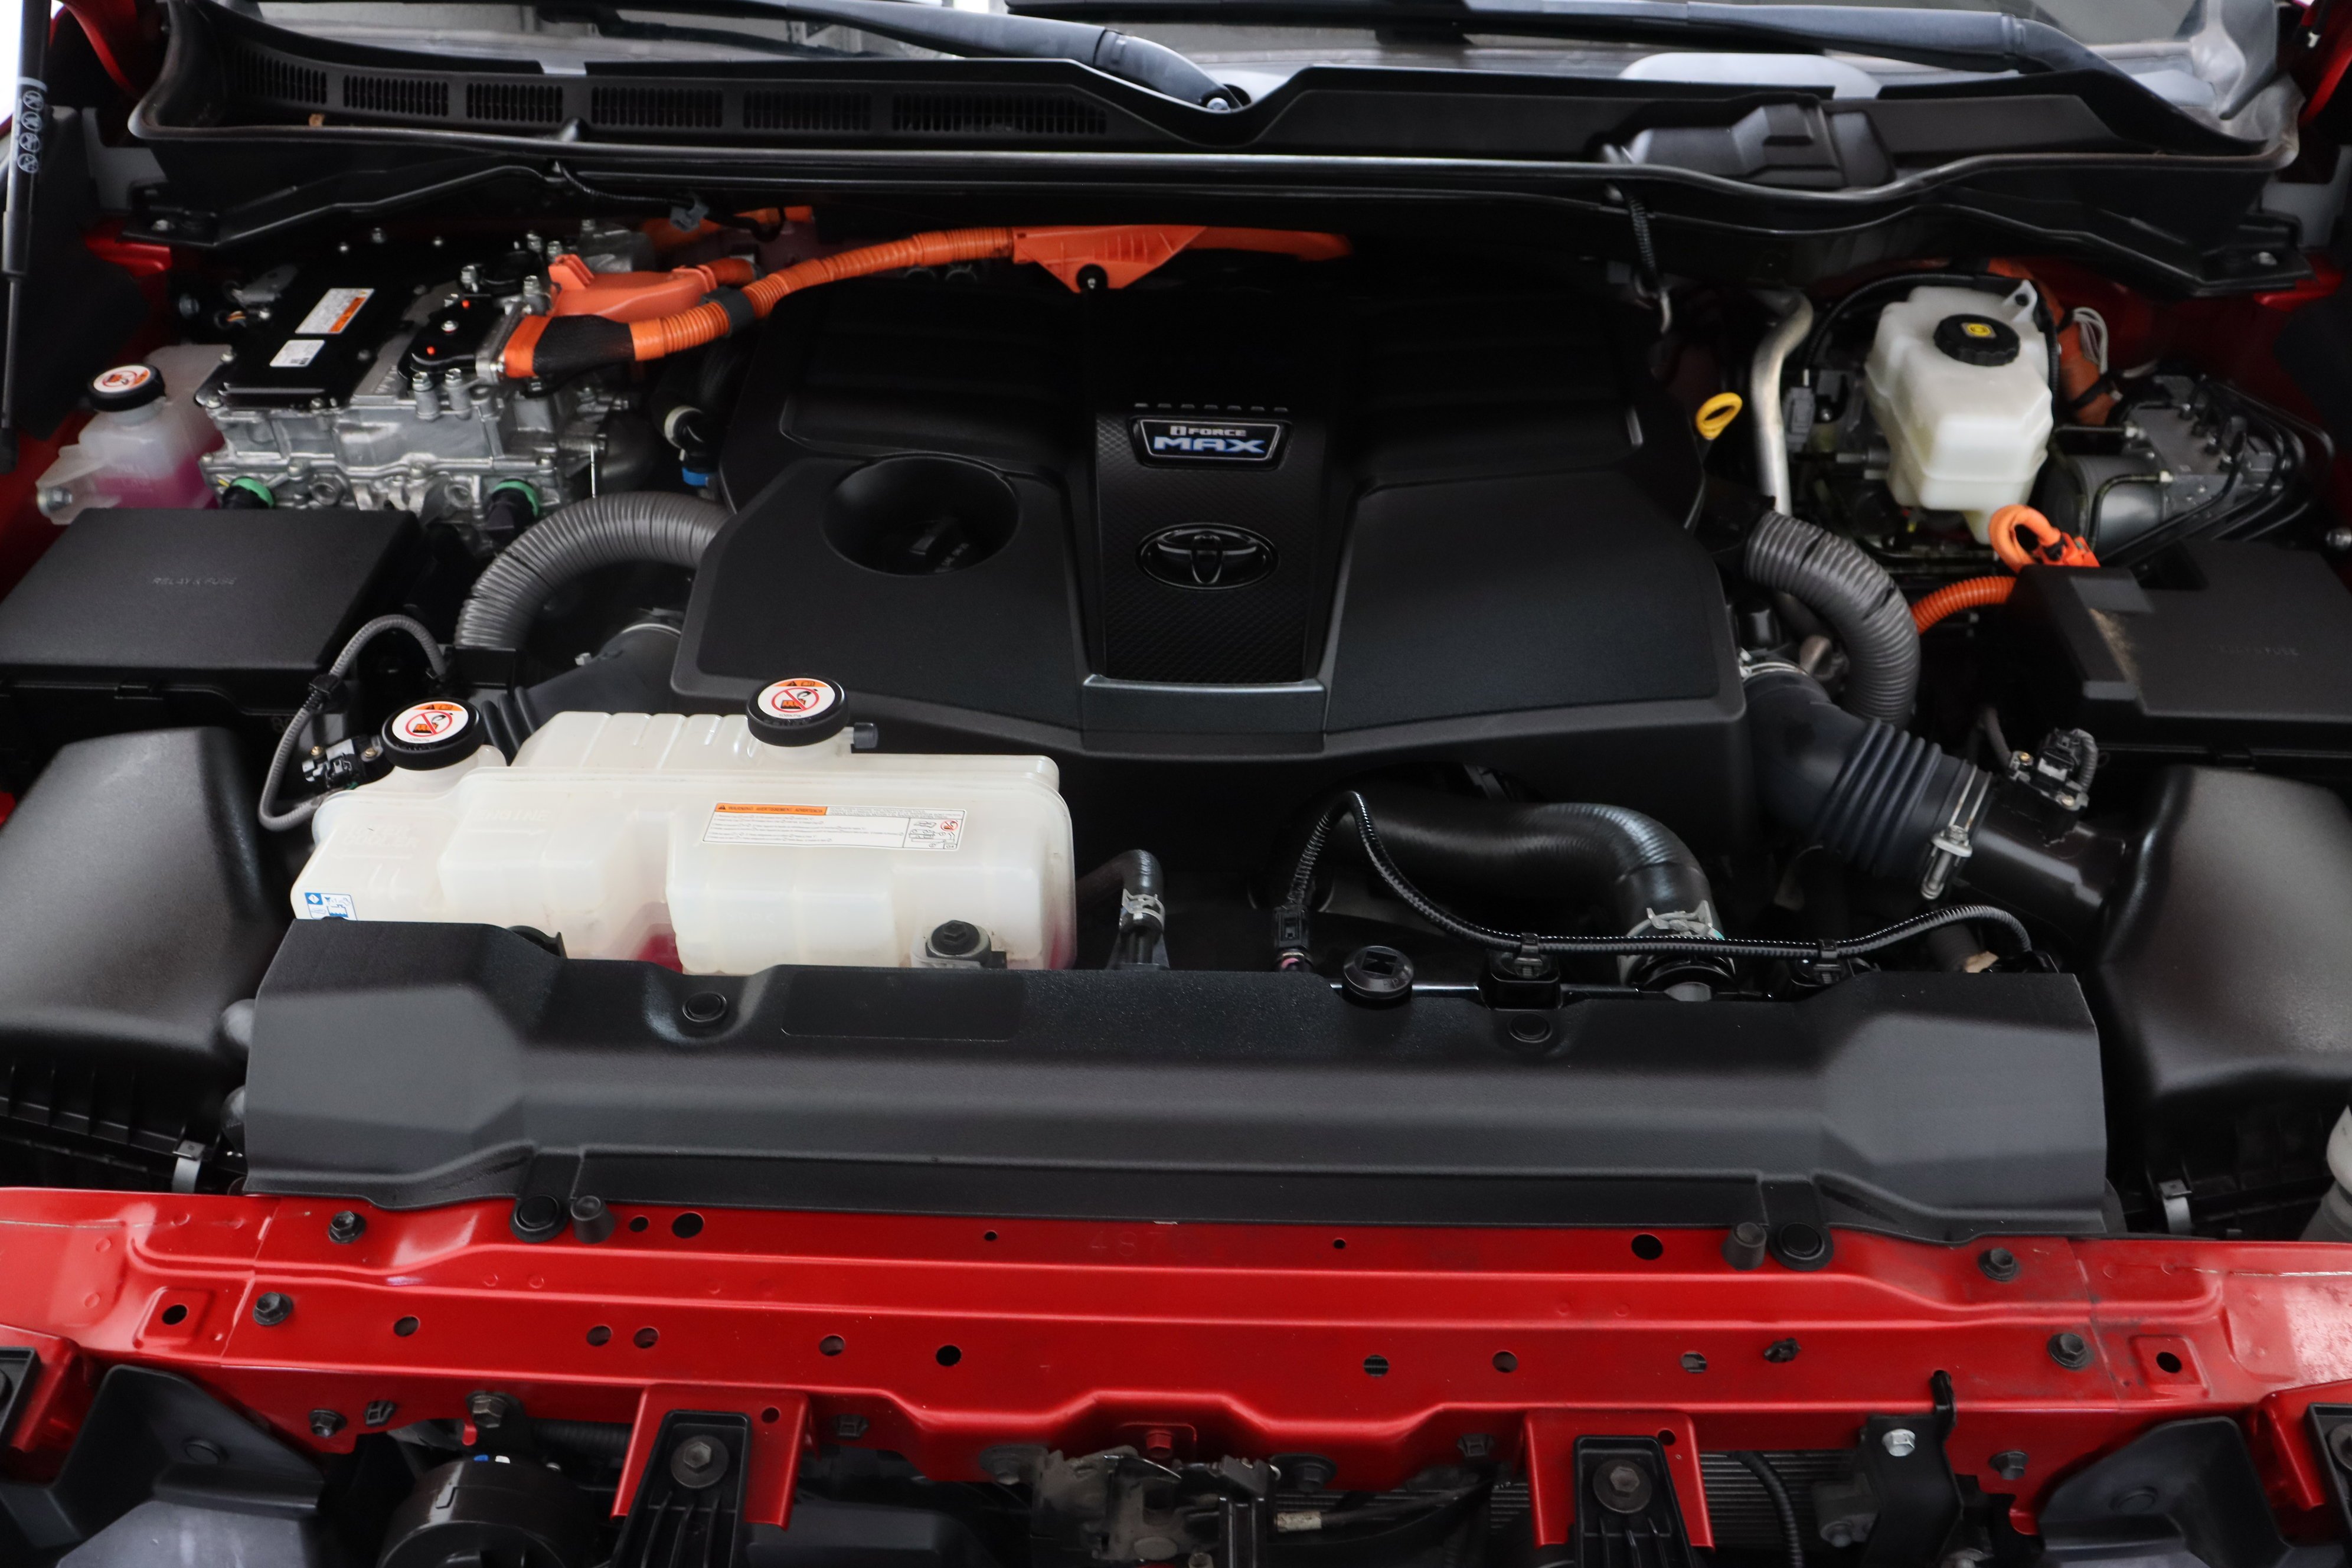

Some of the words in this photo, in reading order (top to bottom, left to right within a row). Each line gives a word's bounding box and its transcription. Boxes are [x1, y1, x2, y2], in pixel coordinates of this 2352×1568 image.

[1188, 427, 1246, 437] FORCE
[1154, 436, 1265, 453] MAX
[472, 809, 551, 821] ENGINE
